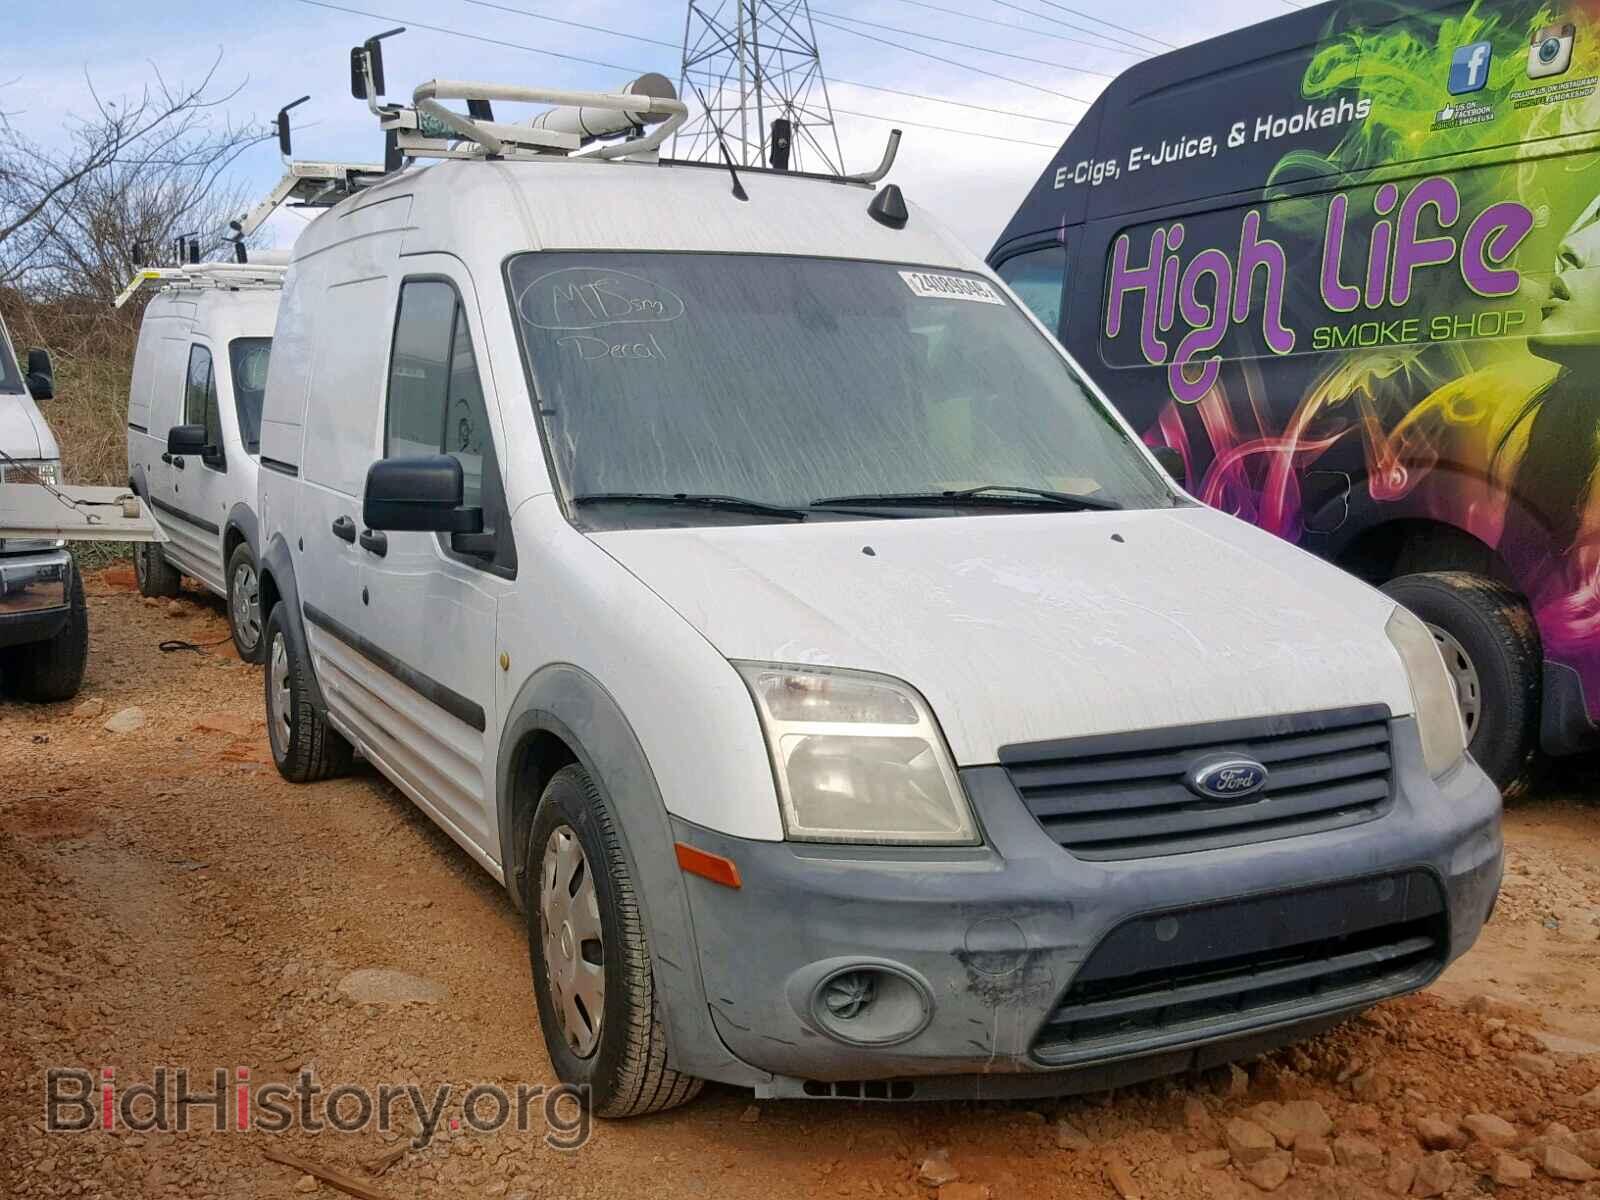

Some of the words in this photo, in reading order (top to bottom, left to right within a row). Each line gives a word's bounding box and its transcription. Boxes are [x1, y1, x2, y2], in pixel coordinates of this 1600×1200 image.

[1054, 158, 1121, 190] E-Cigs,
[1127, 135, 1219, 172] E-Juice,
[1227, 121, 1246, 149] &
[1253, 97, 1371, 143] Hookahs
[1106, 209, 1296, 404] High
[1311, 317, 1425, 350] SMOKE
[1429, 310, 1527, 341] SHOP
[1216, 768, 1254, 790] Ford
